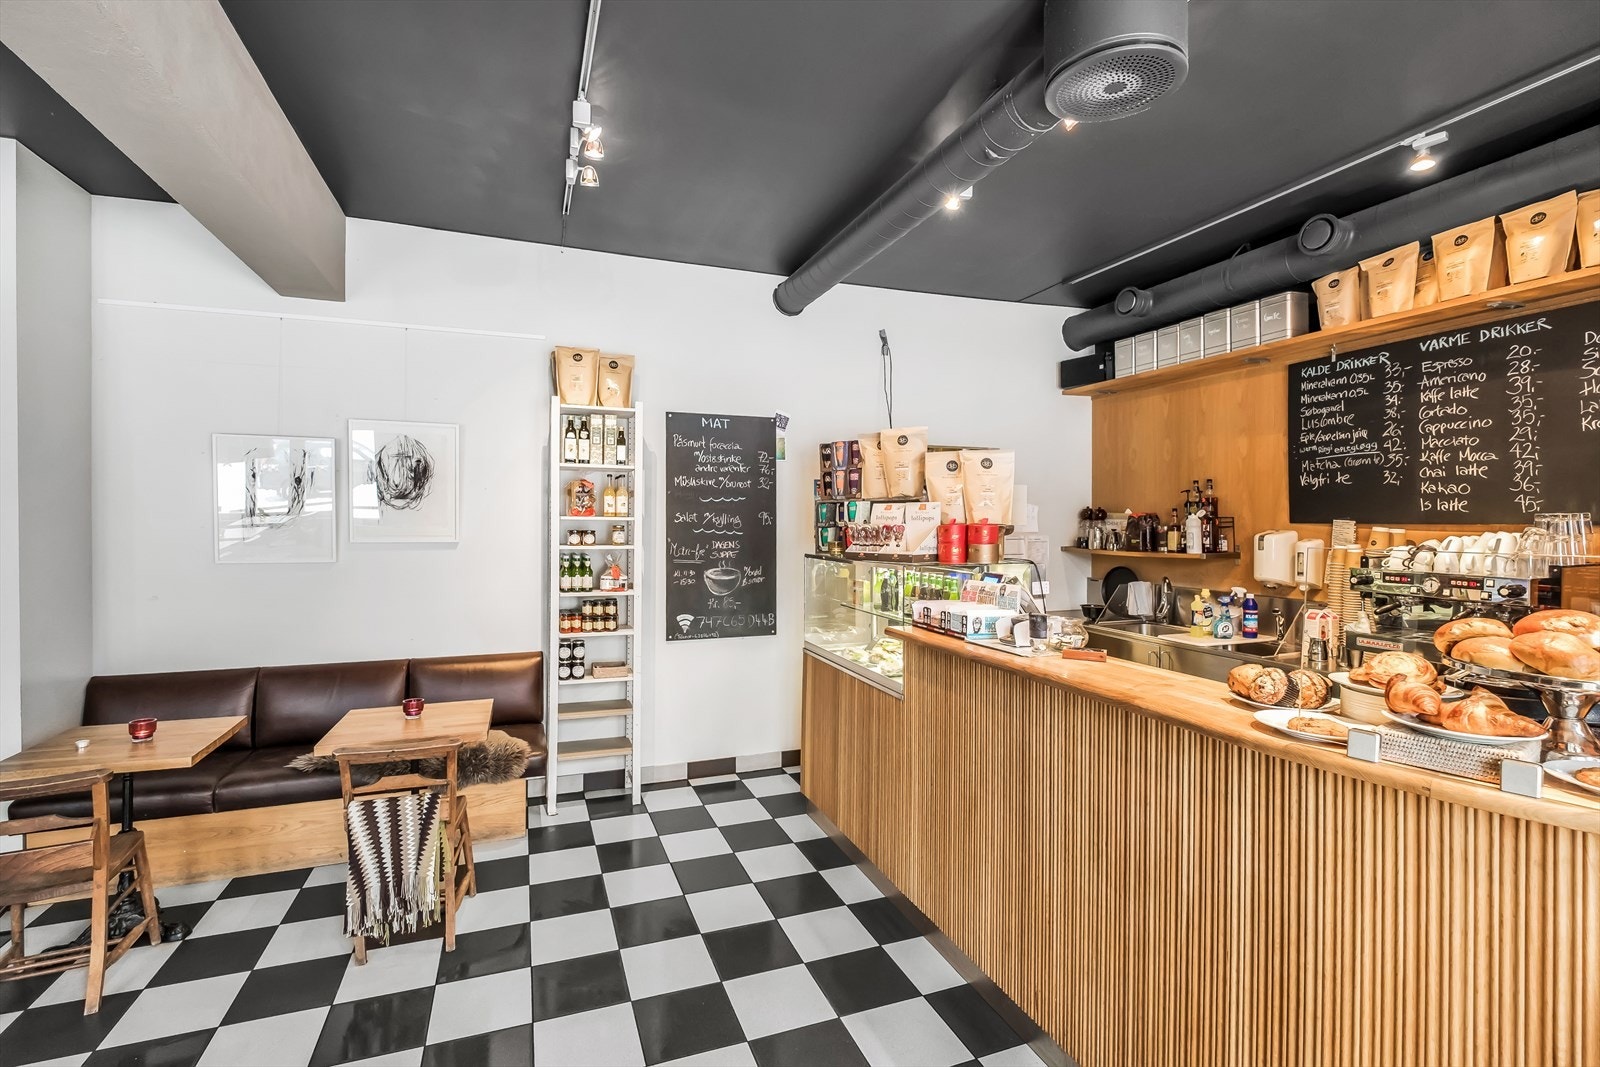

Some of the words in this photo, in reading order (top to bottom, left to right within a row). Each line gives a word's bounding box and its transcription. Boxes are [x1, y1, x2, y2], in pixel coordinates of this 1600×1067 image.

[1419, 332, 1472, 352] VARME
[1479, 318, 1553, 343] DRIKKER
[1301, 364, 1331, 378] KALDE
[1421, 357, 1473, 374] Espresso
[1417, 371, 1487, 389] Americano
[1420, 388, 1446, 404] Kaffe
[1450, 386, 1480, 400] latte
[1418, 403, 1468, 420] Cortado
[701, 417, 731, 429] MAT
[1418, 415, 1493, 436] Cappuccino
[673, 433, 706, 449] Påsmurt
[709, 437, 743, 452] focaccia
[1419, 450, 1451, 466] Kaffe
[1459, 448, 1500, 462] Mocca
[694, 464, 718, 473] andre
[1301, 459, 1341, 472] Matcha
[1419, 465, 1446, 478] Chai
[1455, 464, 1489, 478] latte
[1300, 472, 1330, 490] Valgfri
[1335, 471, 1353, 485] te
[1420, 481, 1471, 495] Kakao
[1420, 497, 1432, 512] Is
[1437, 497, 1469, 513] latte
[674, 511, 698, 523] Salat
[712, 540, 741, 550] DAGENS
[709, 550, 740, 559] SUPPE
